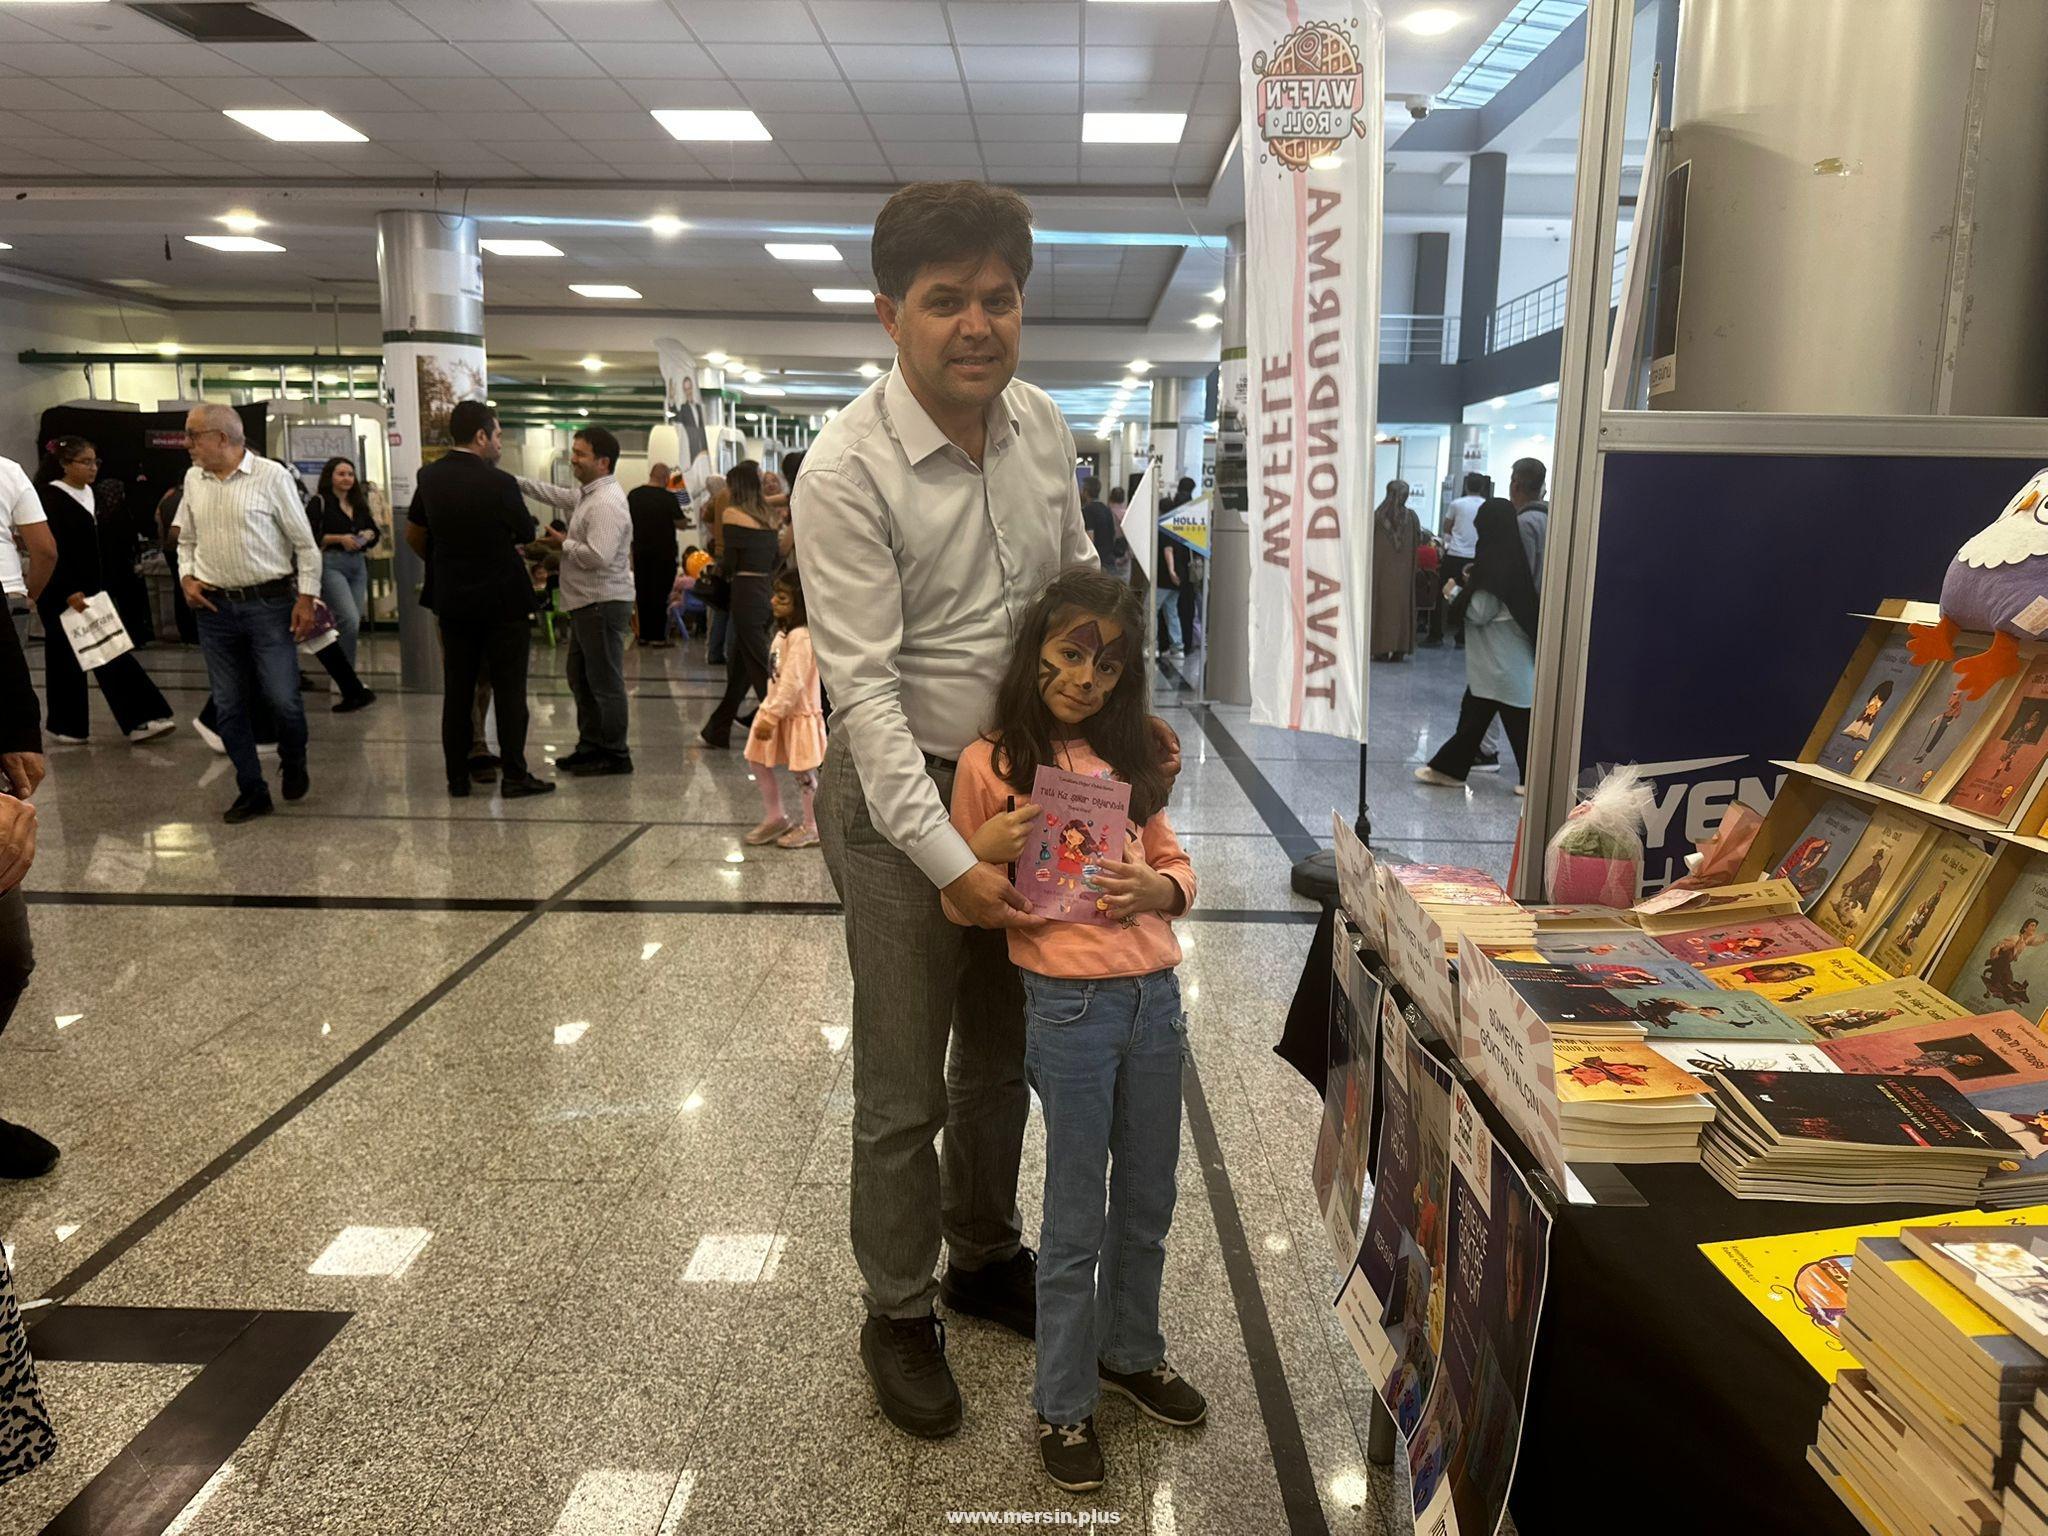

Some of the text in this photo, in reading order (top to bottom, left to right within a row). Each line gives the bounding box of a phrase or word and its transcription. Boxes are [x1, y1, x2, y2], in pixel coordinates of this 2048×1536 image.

[1480, 1028, 1540, 1116] GÖKTAŞ YALÇIN
[1488, 1007, 1524, 1065] SÜMEYYE
